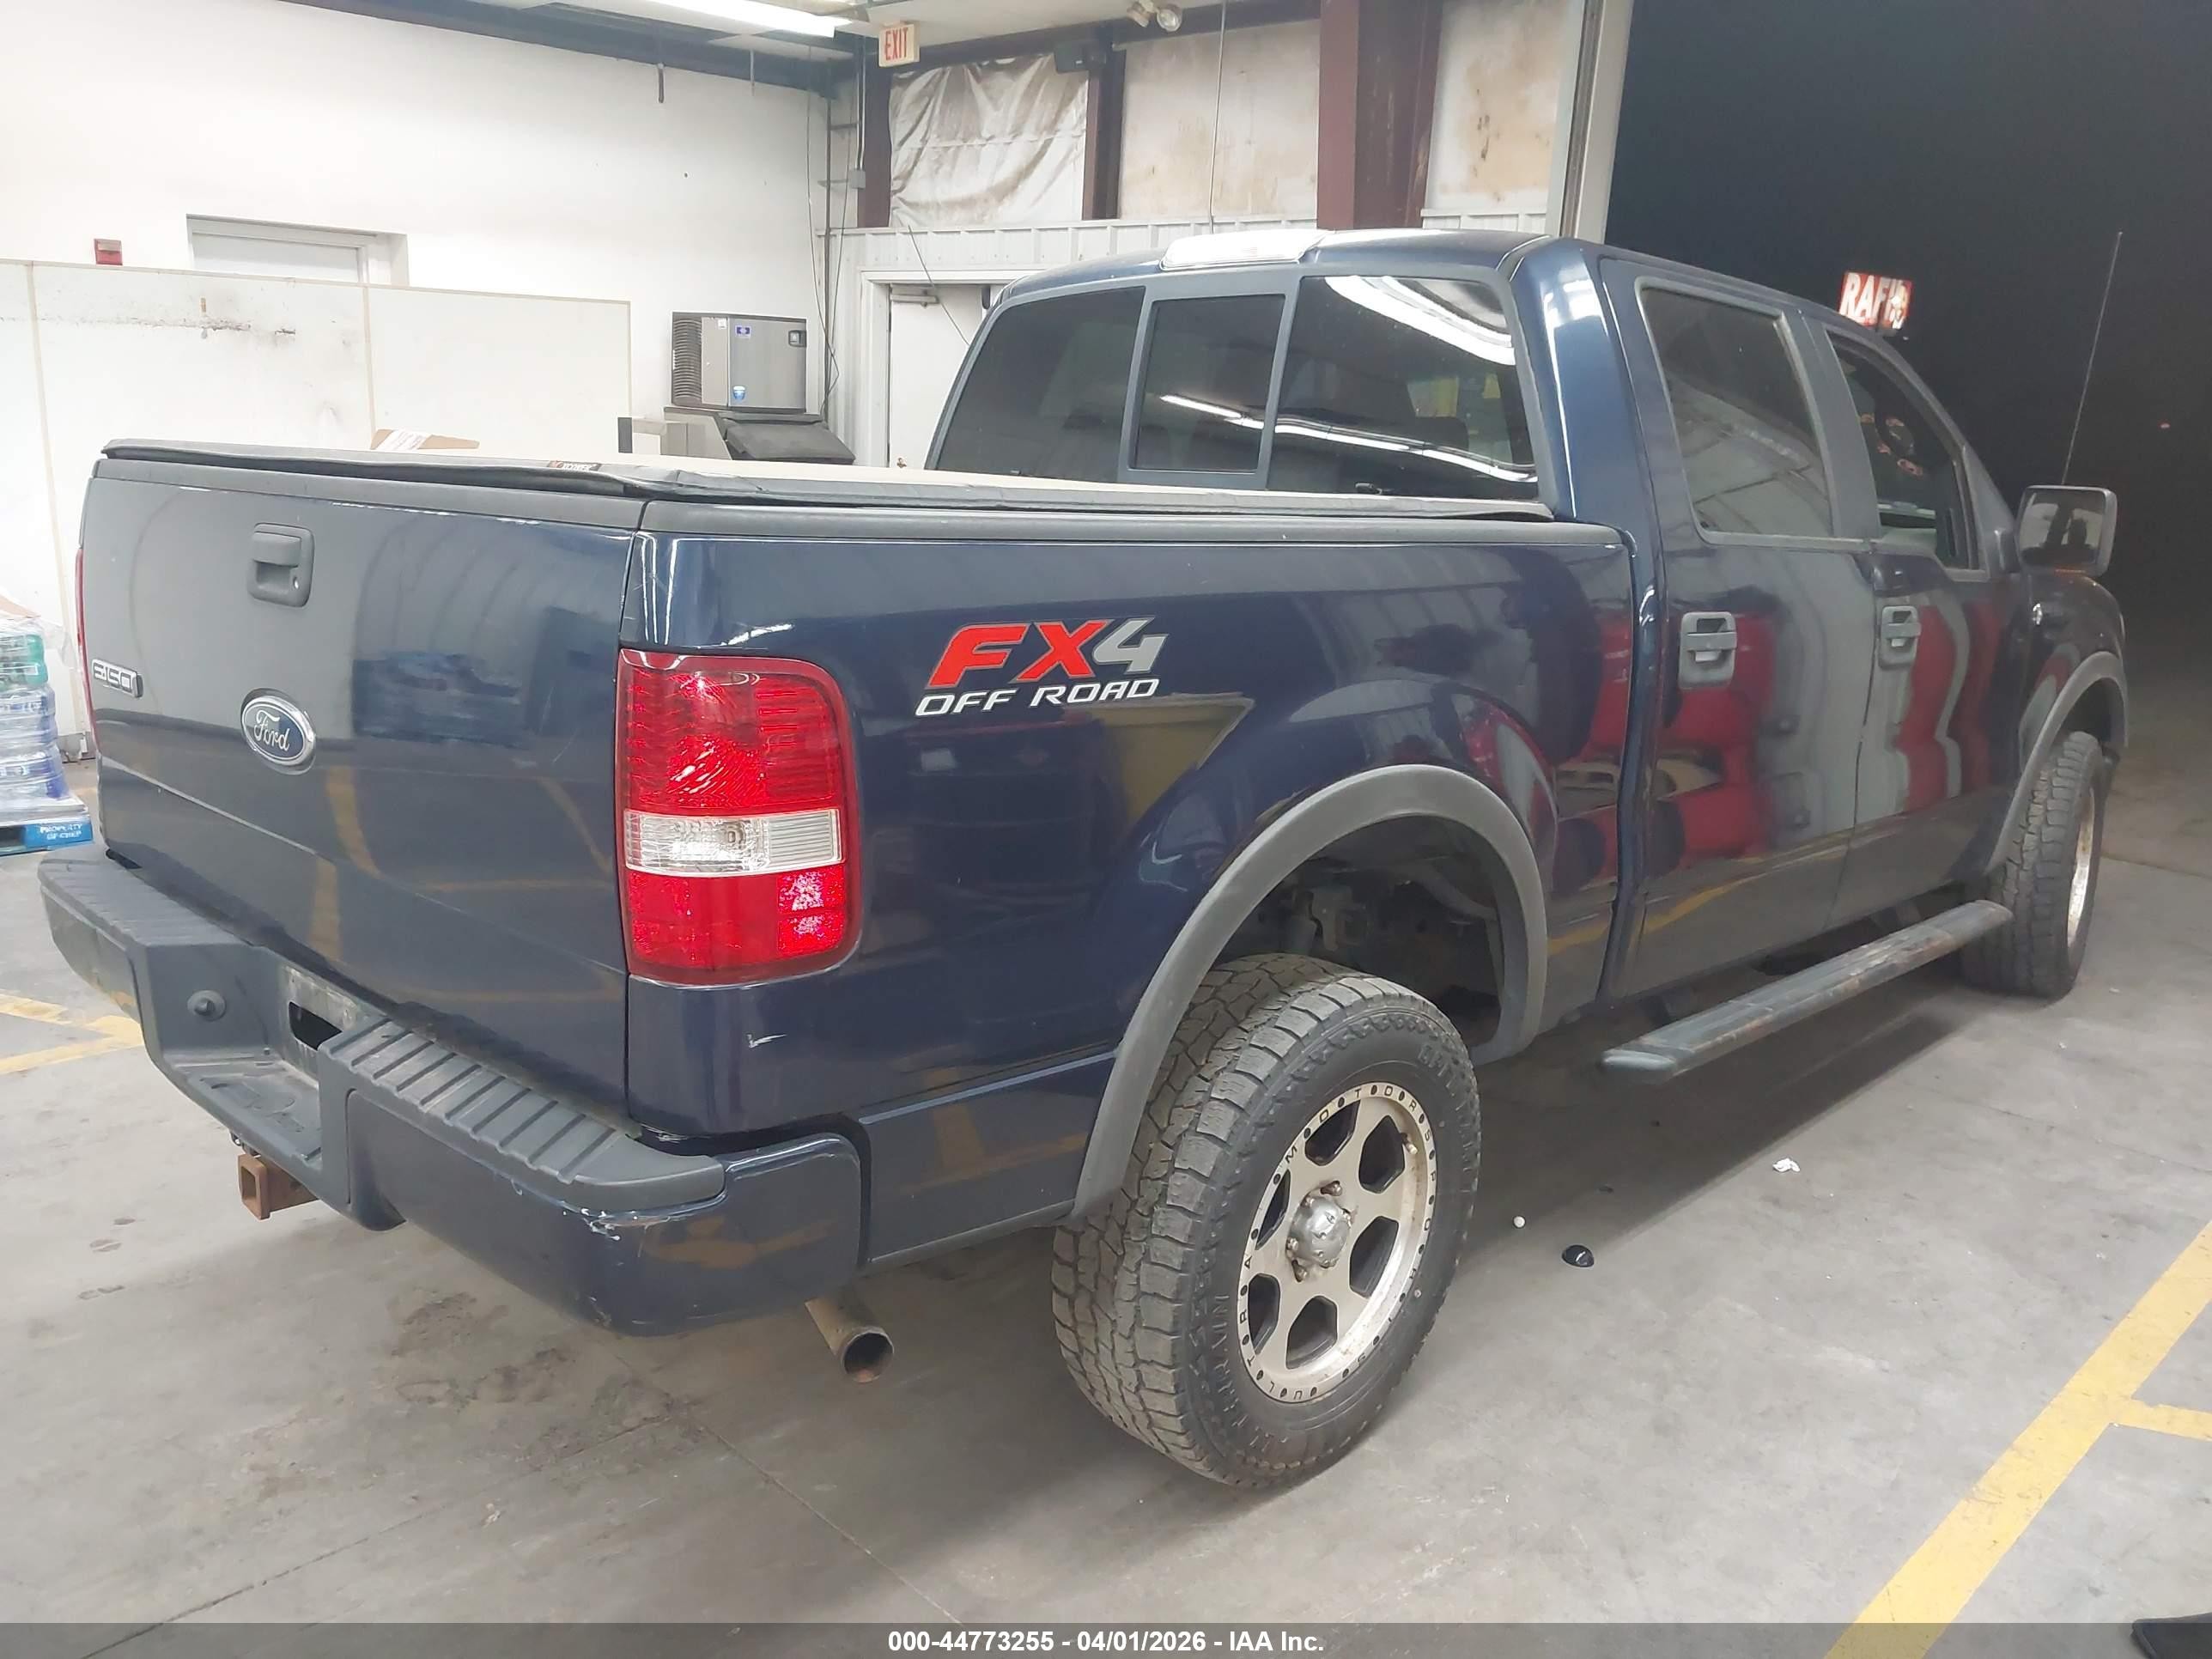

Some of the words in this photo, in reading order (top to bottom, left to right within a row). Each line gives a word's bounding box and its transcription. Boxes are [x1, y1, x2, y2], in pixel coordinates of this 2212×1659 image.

[884, 27, 908, 60] EXIT
[924, 617, 1169, 689] FX4
[915, 690, 1018, 716] OFF
[1029, 678, 1160, 708] ROAD
[253, 709, 291, 752] Ford
